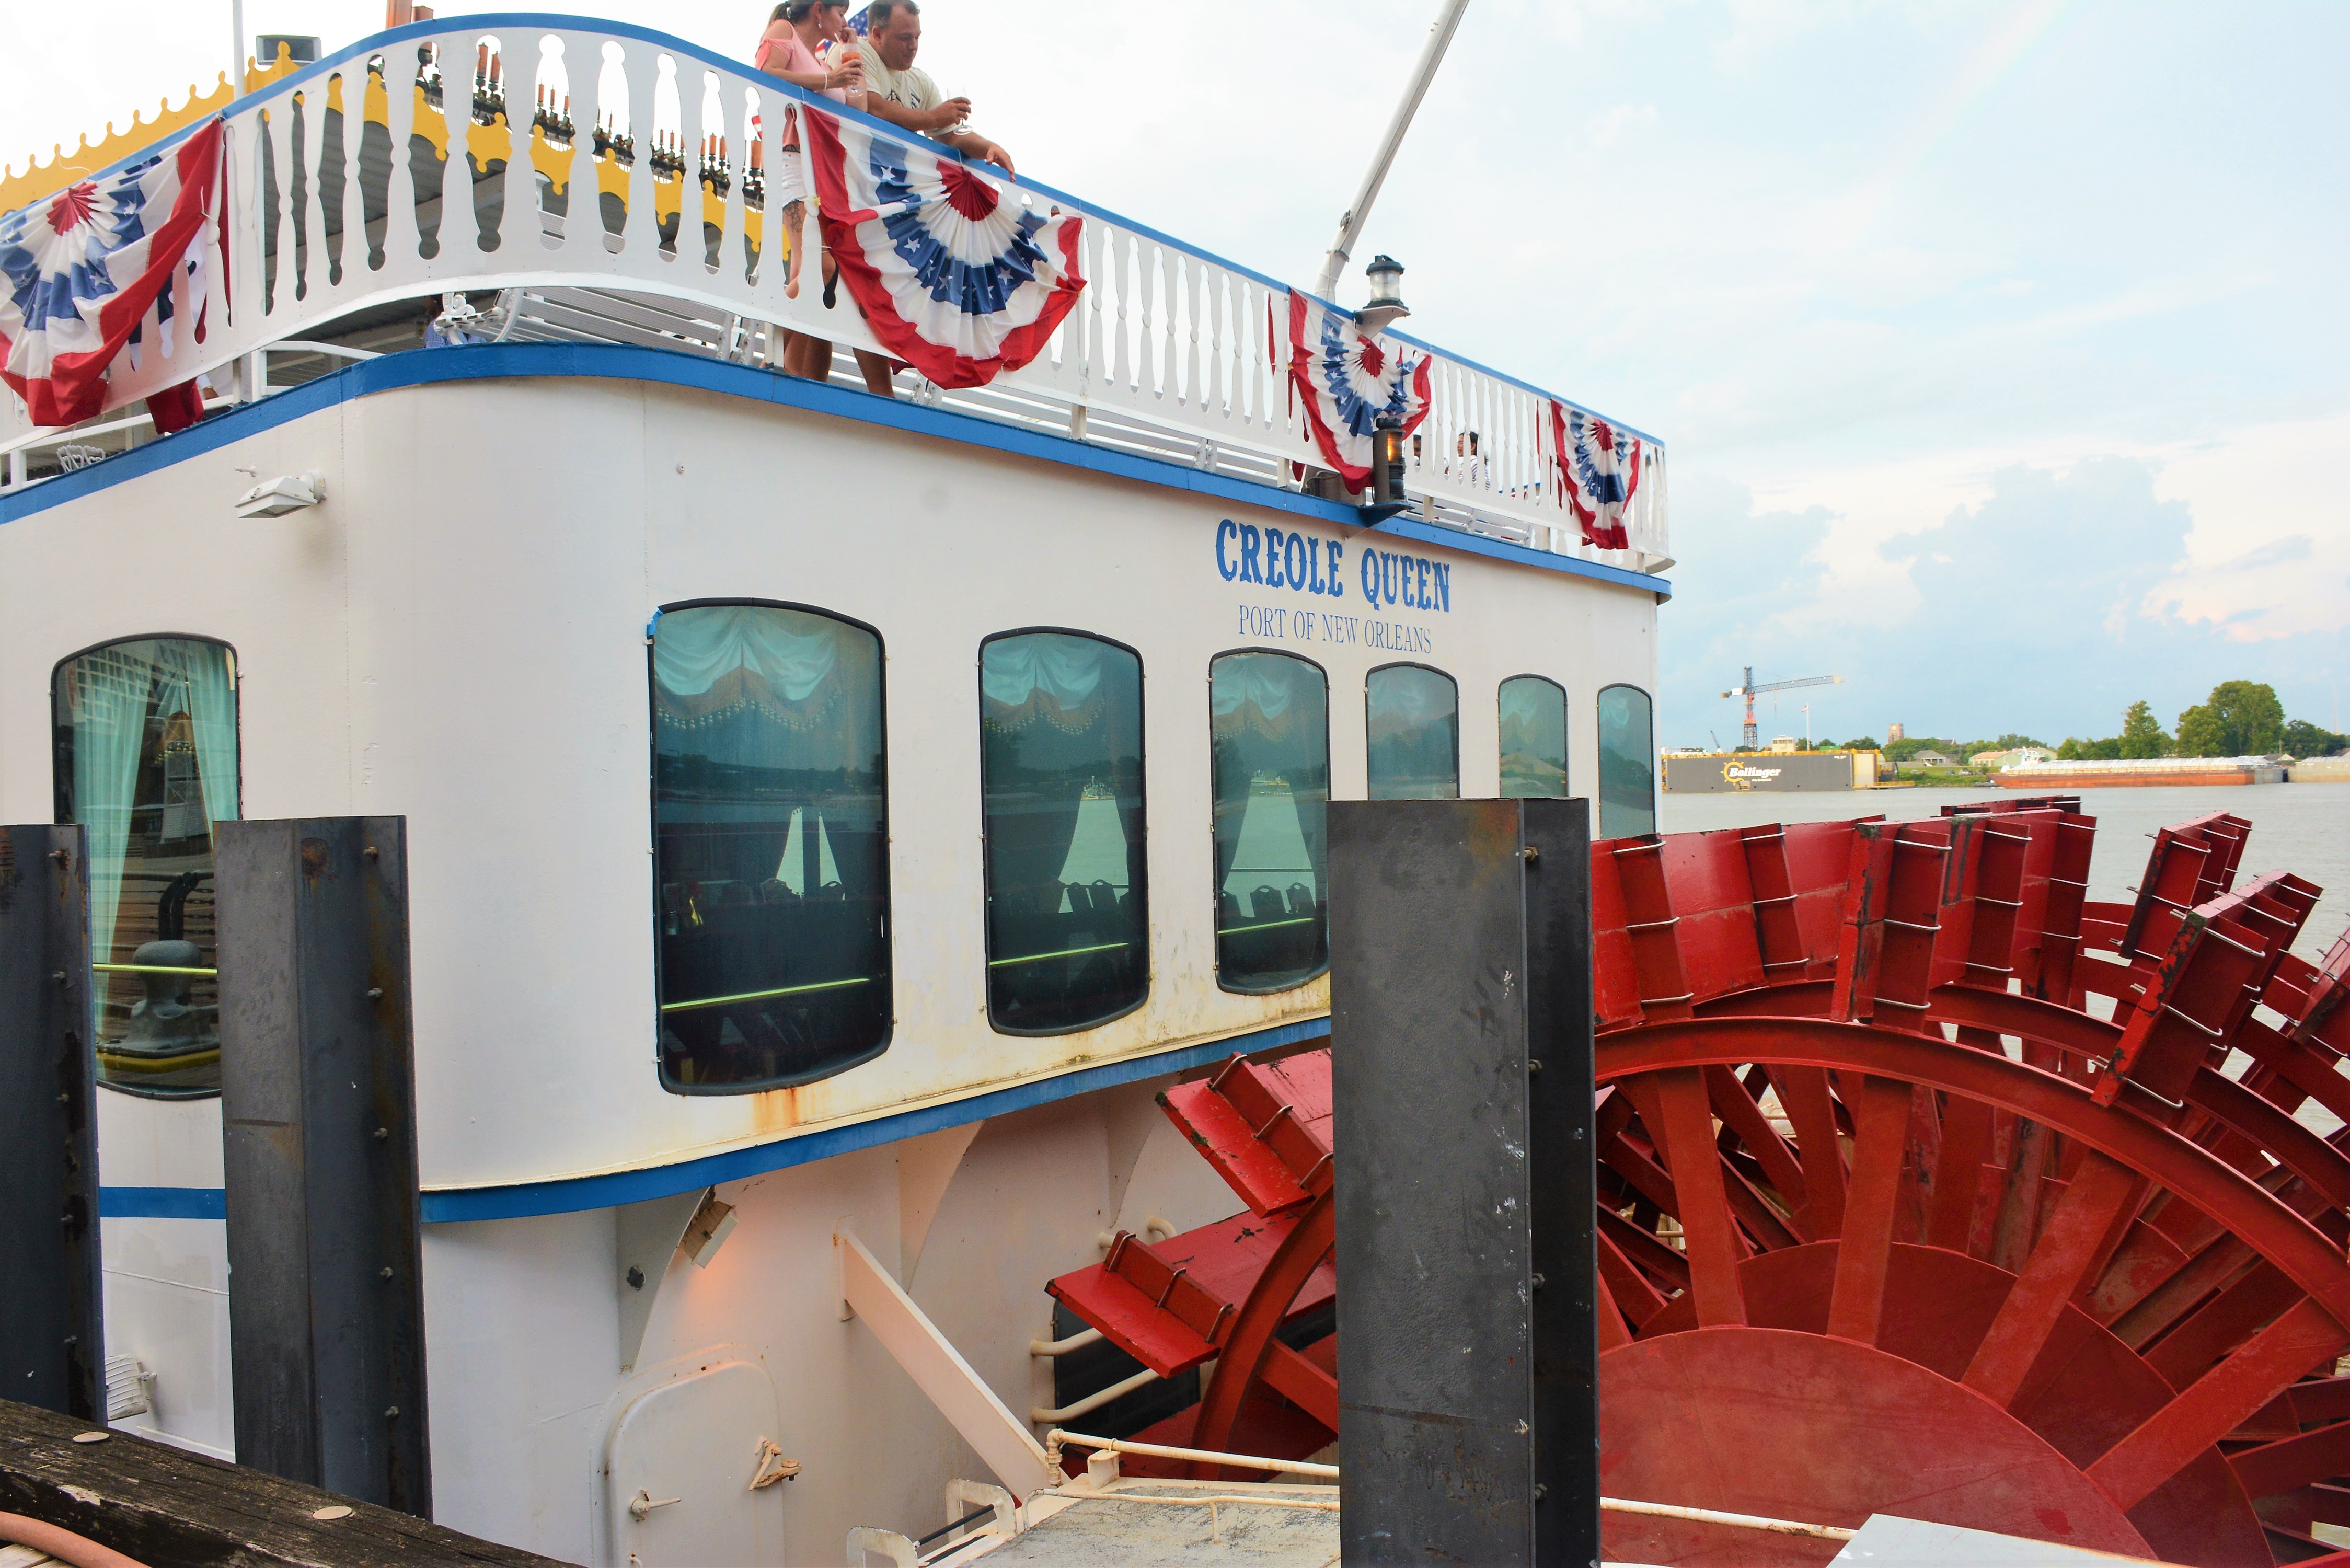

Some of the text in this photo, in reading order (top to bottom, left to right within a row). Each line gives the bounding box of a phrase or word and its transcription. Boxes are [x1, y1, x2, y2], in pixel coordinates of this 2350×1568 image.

[1216, 519, 1450, 613] CREOLE QUEEN
[1239, 605, 1432, 654] PORT OF NEW ORLEANS
[1729, 767, 1781, 778] Bollinger
